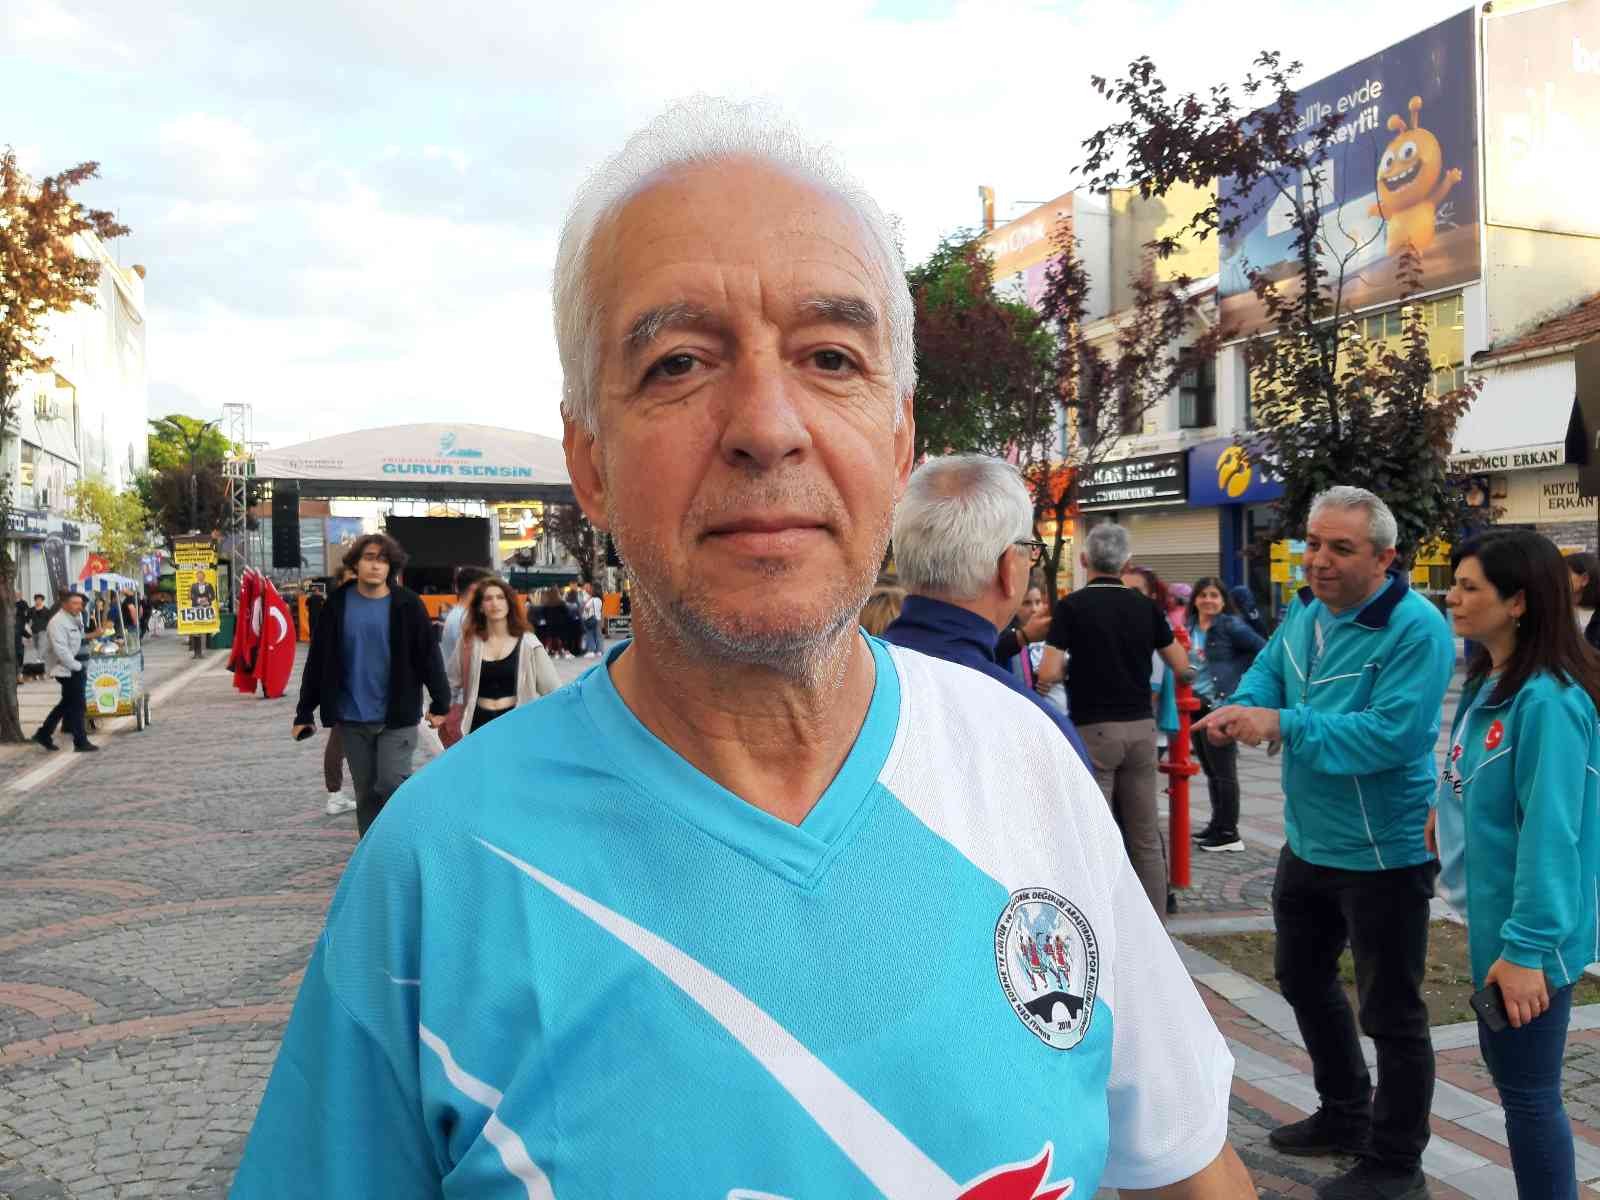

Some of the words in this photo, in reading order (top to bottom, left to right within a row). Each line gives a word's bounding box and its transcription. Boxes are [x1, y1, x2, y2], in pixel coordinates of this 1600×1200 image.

[1337, 79, 1383, 113] evde
[1513, 450, 1558, 466] ERKAN
[1548, 495, 1594, 510] ERKAN
